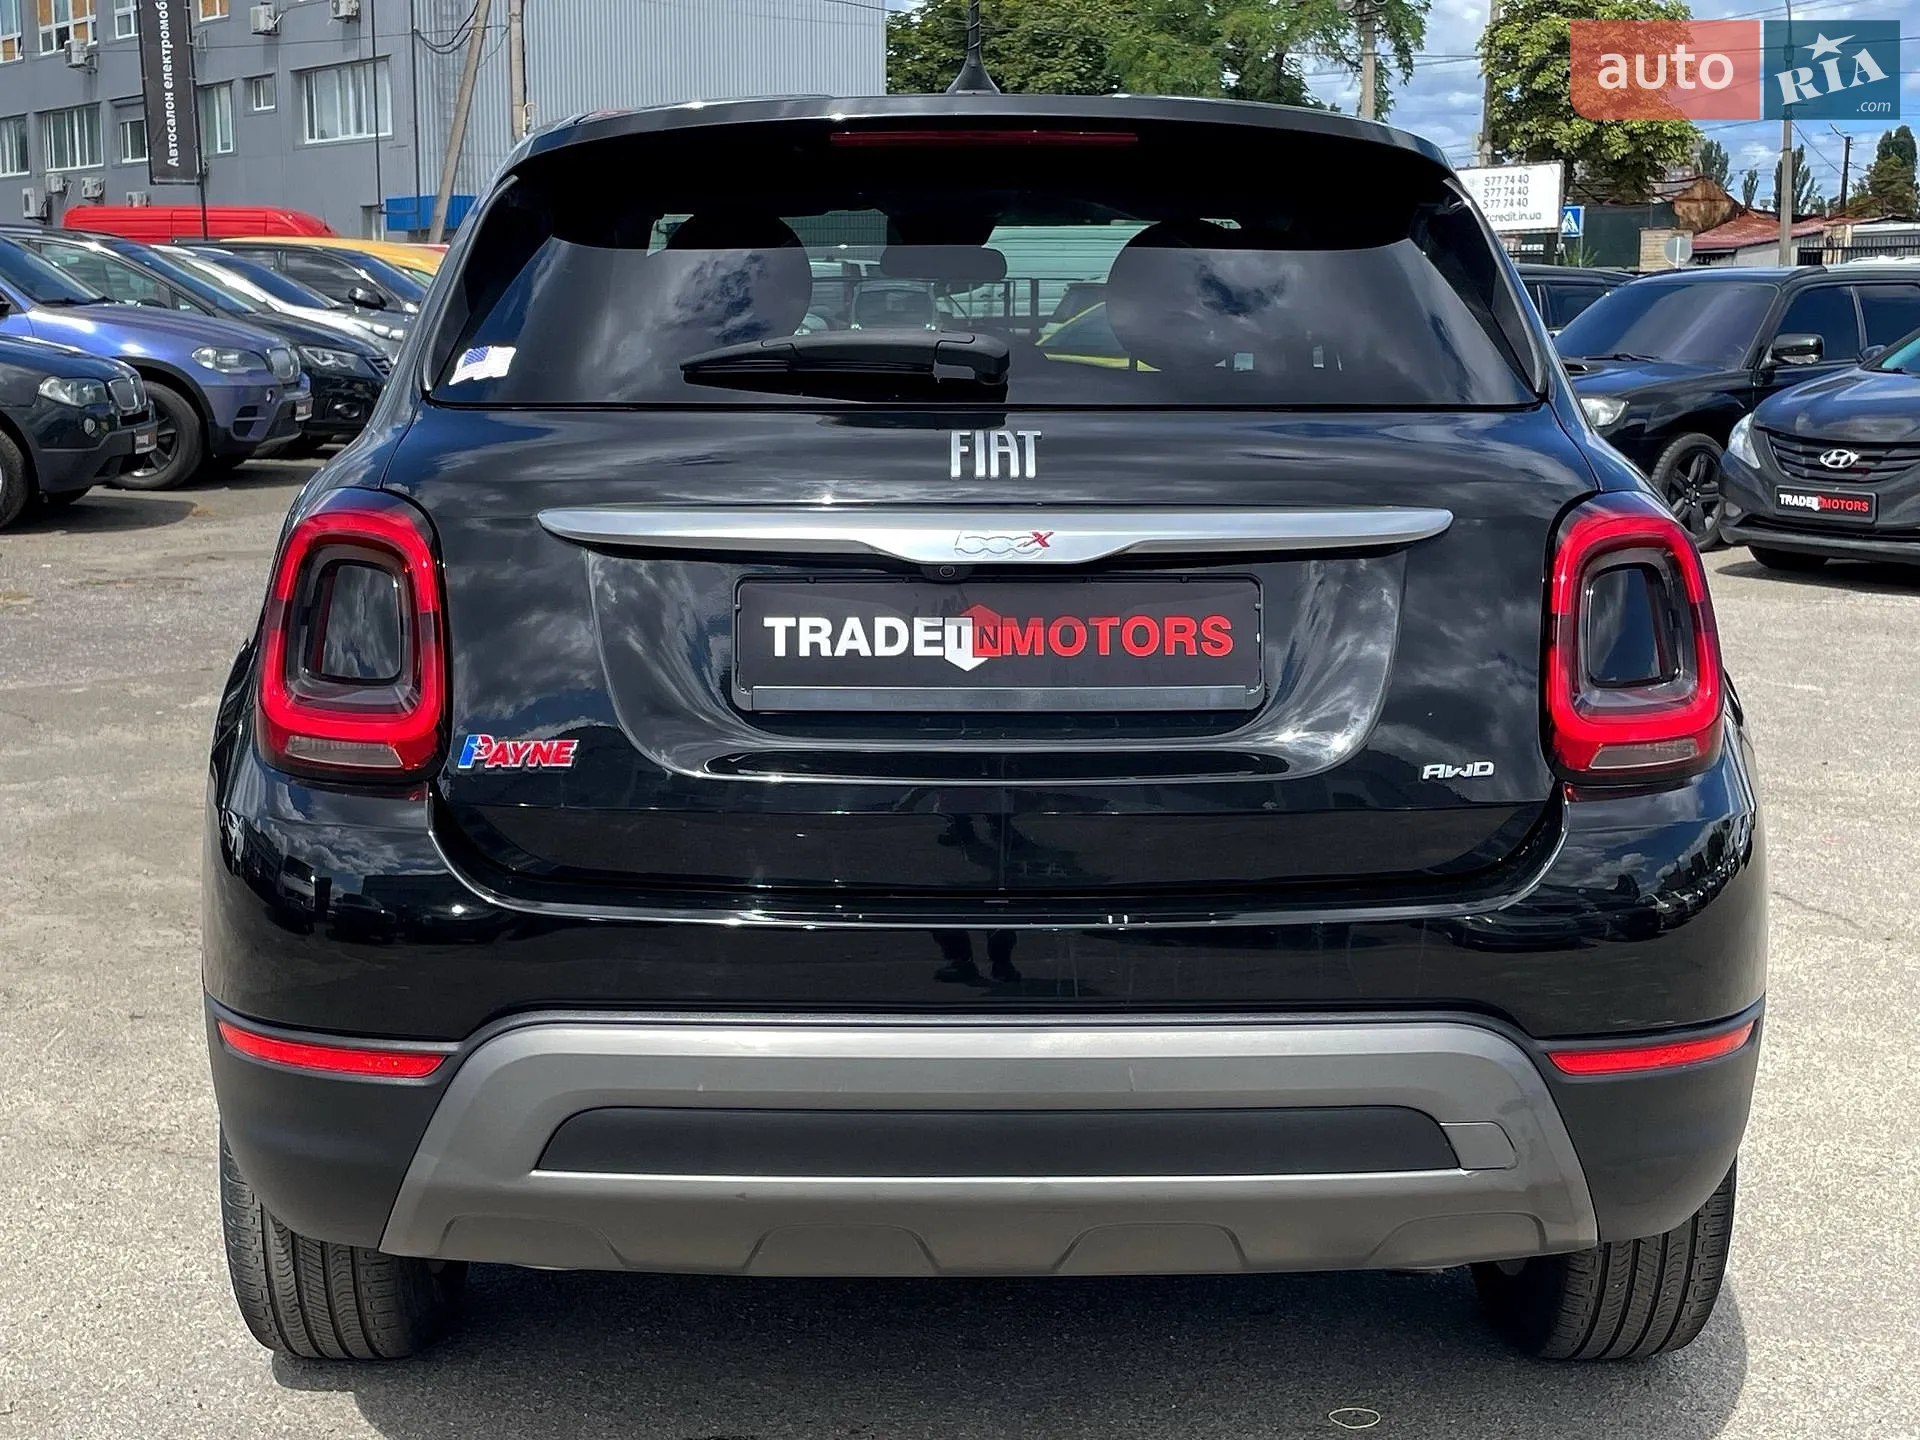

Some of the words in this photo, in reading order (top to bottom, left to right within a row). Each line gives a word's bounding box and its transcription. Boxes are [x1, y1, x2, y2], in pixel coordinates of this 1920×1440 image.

[155, 0, 174, 90] електромоб
[165, 92, 179, 167] Автосалон
[1485, 211, 1542, 223] credit.in.ua
[951, 430, 1041, 479] FIAT
[458, 734, 579, 768] PAYNE
[1422, 761, 1494, 779] AWD
